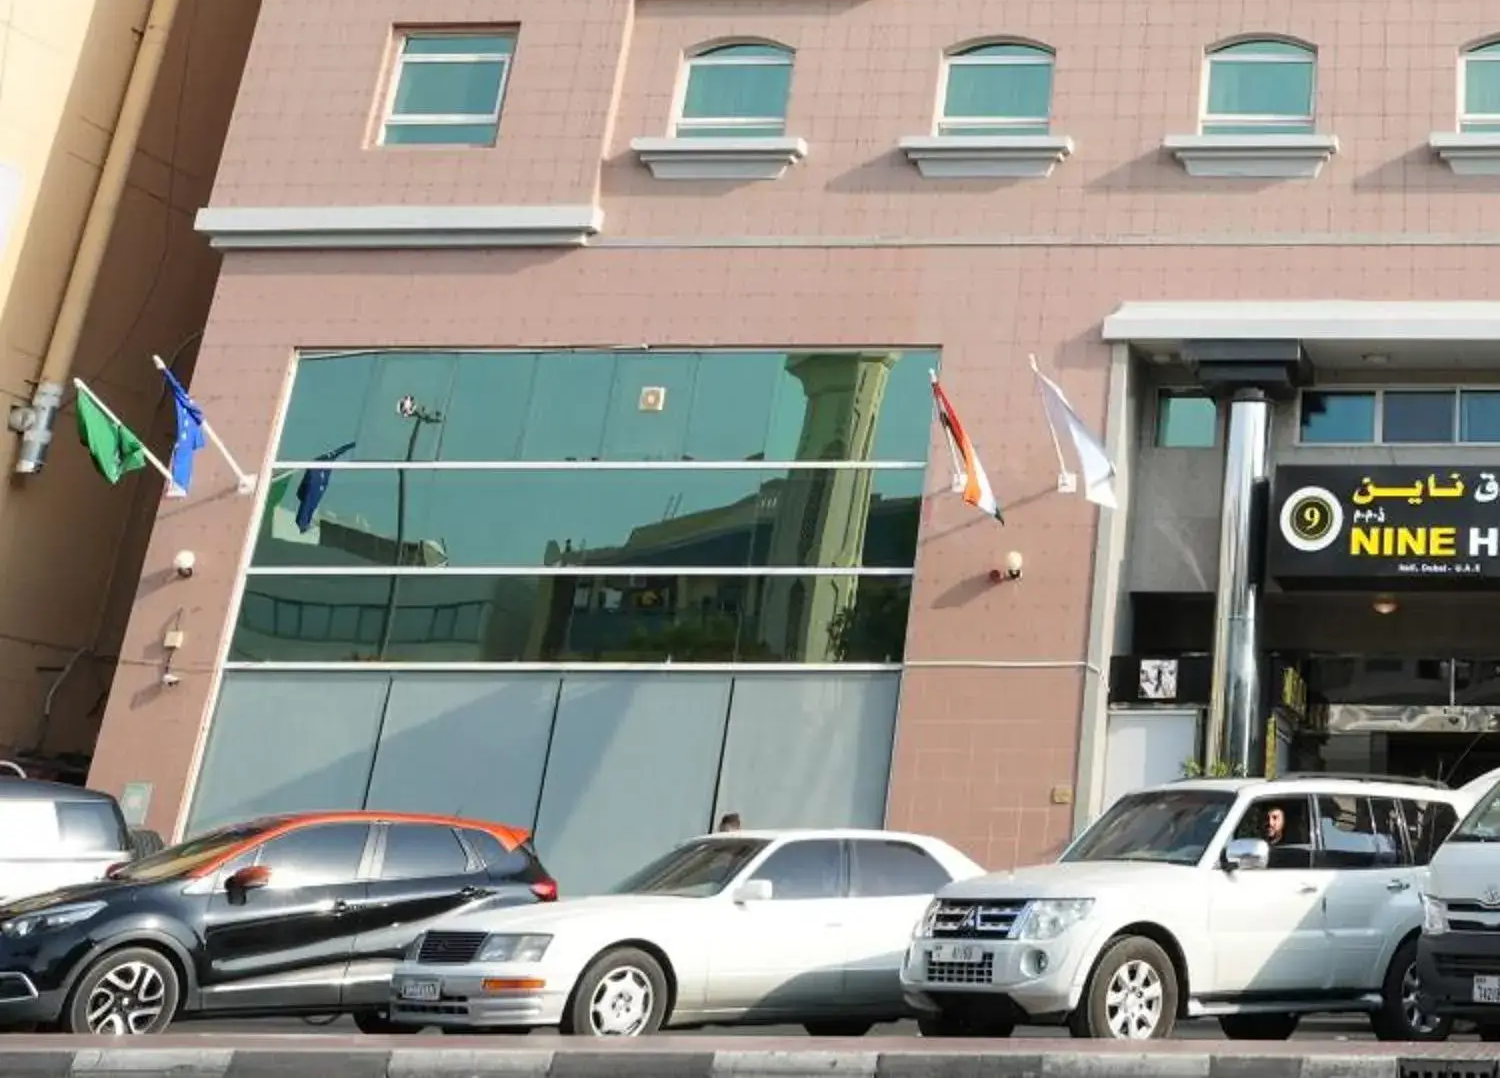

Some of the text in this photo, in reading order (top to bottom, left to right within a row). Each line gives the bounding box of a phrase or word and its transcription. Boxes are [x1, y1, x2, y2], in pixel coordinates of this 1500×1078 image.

[1352, 473, 1465, 505] ناين
[1303, 506, 1321, 530] 9
[1350, 527, 1457, 556] NINE
